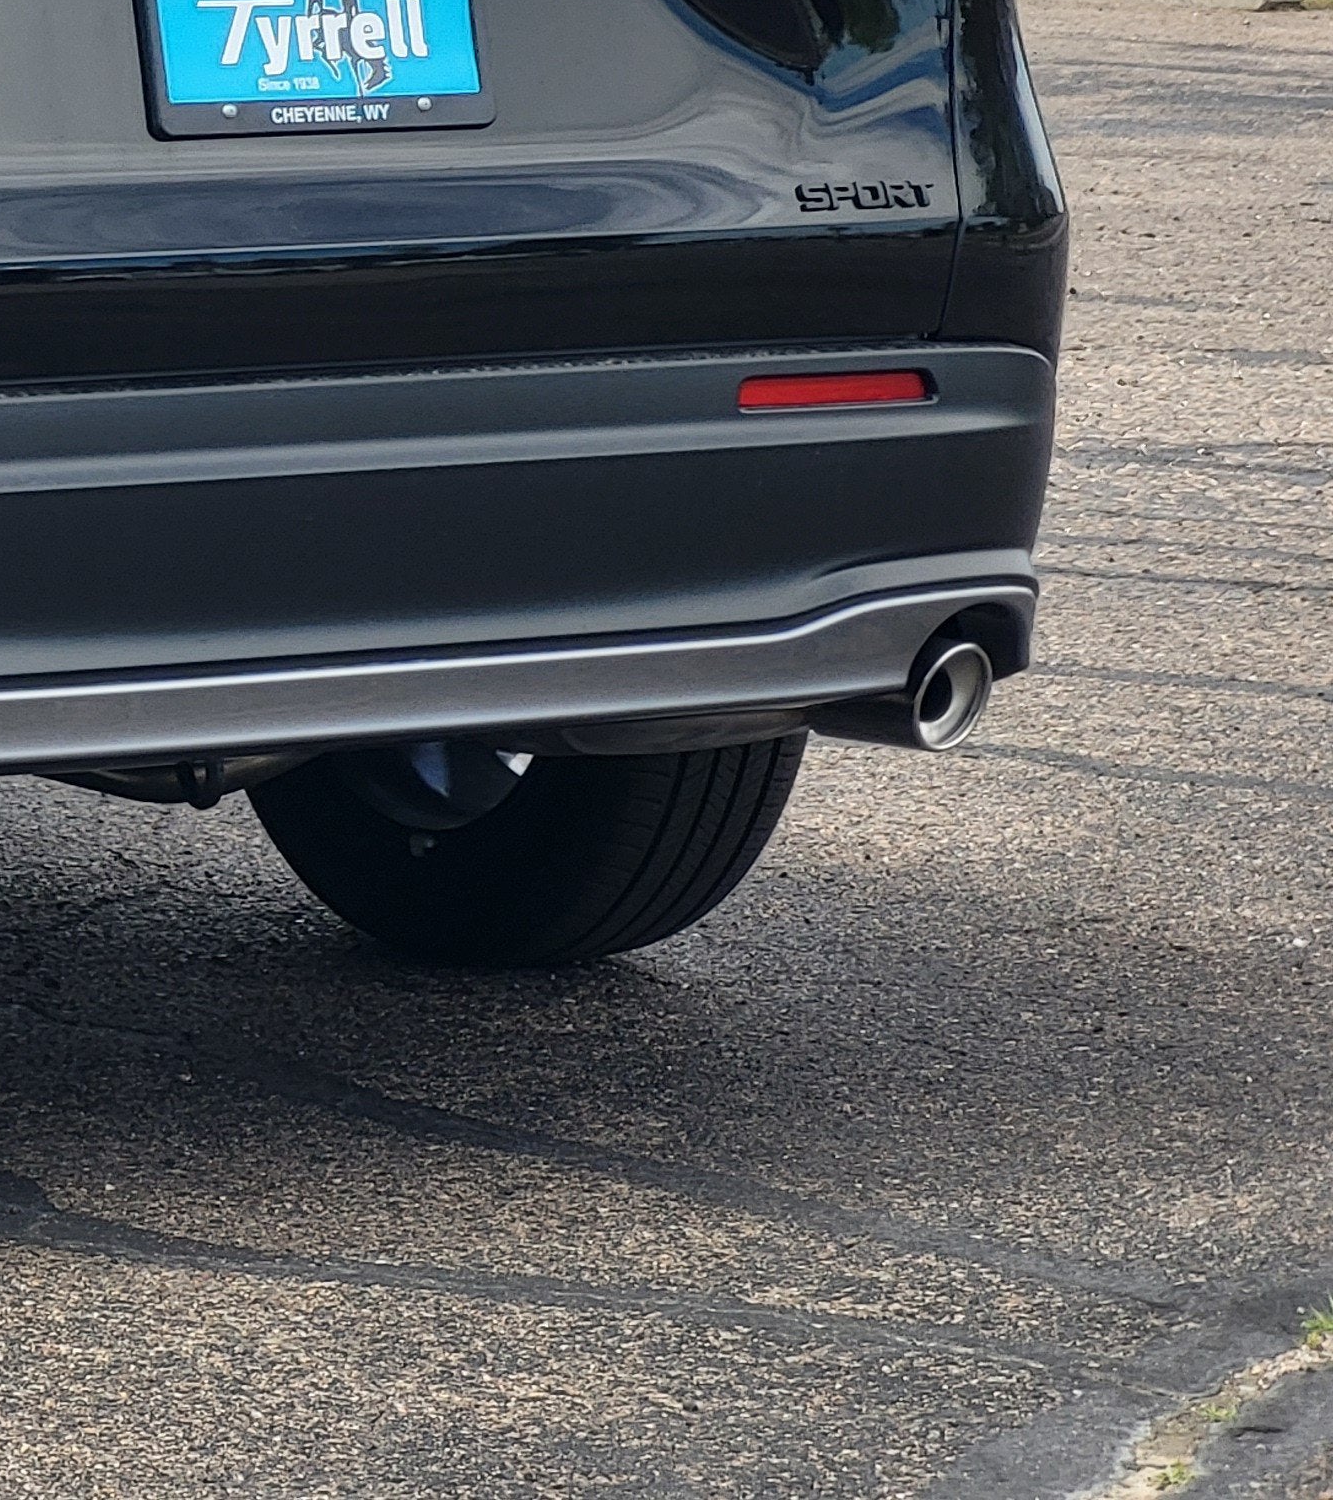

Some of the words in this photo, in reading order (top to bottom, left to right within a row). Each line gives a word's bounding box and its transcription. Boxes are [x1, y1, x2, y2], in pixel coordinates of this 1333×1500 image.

[271, 105, 363, 124] CHEYENNE,
[363, 103, 390, 121] WY
[794, 180, 935, 213] SPORT
